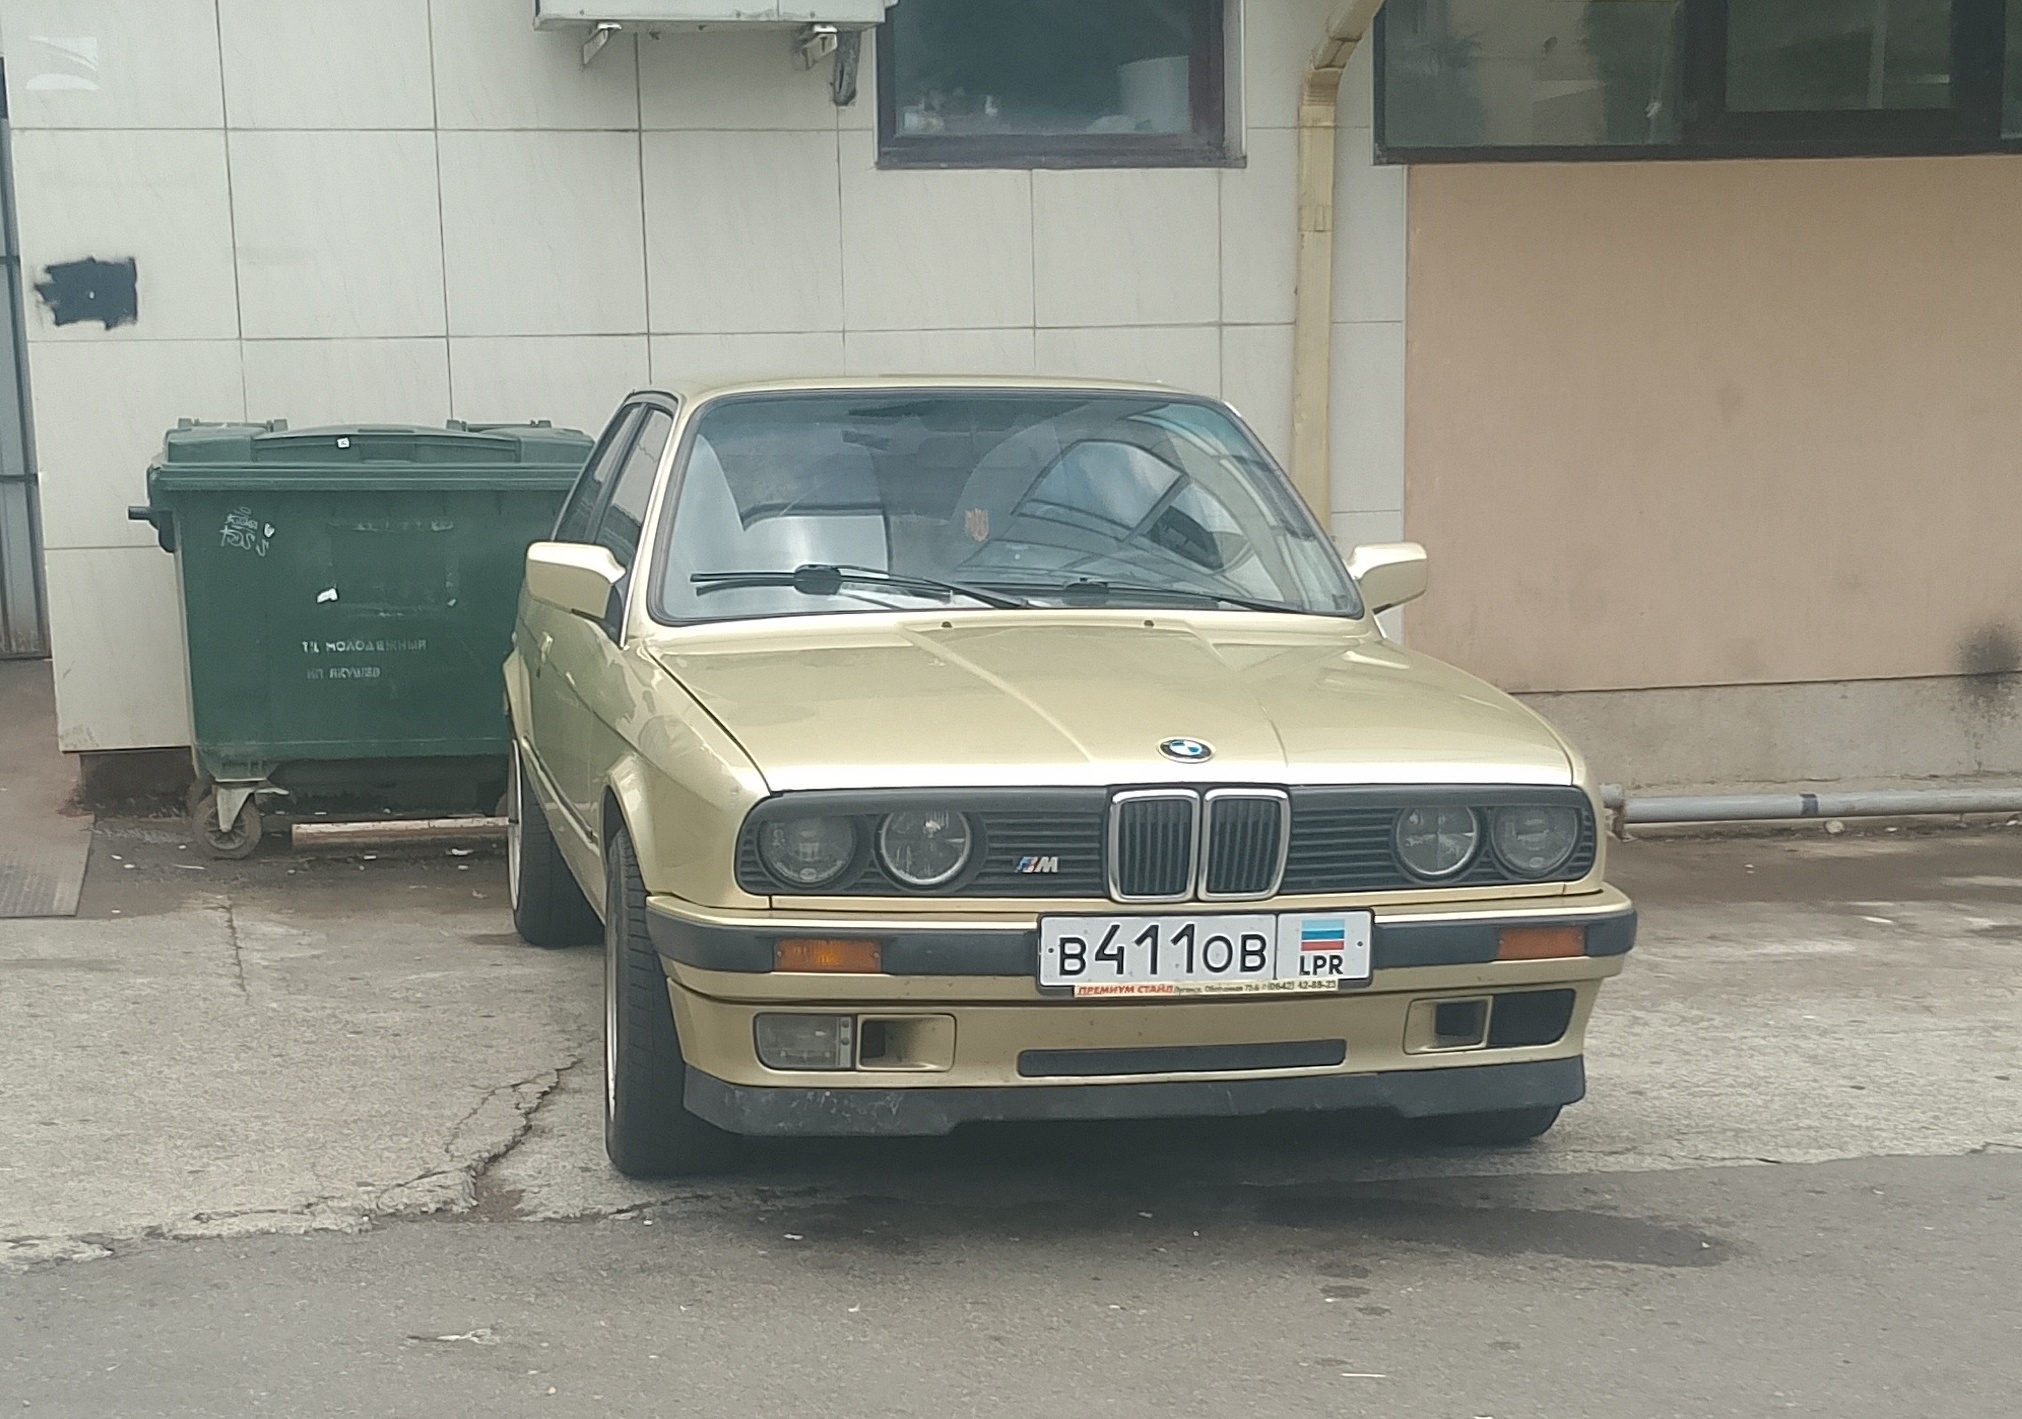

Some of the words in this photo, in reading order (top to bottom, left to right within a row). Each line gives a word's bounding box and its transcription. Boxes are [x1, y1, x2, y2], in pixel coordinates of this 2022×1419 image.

[1058, 923, 1267, 977] В411ОВ
[1299, 954, 1344, 976] LPR
[1077, 985, 1135, 996] ПРЕМИУМ
[1137, 983, 1174, 994] СТАЙЛ
